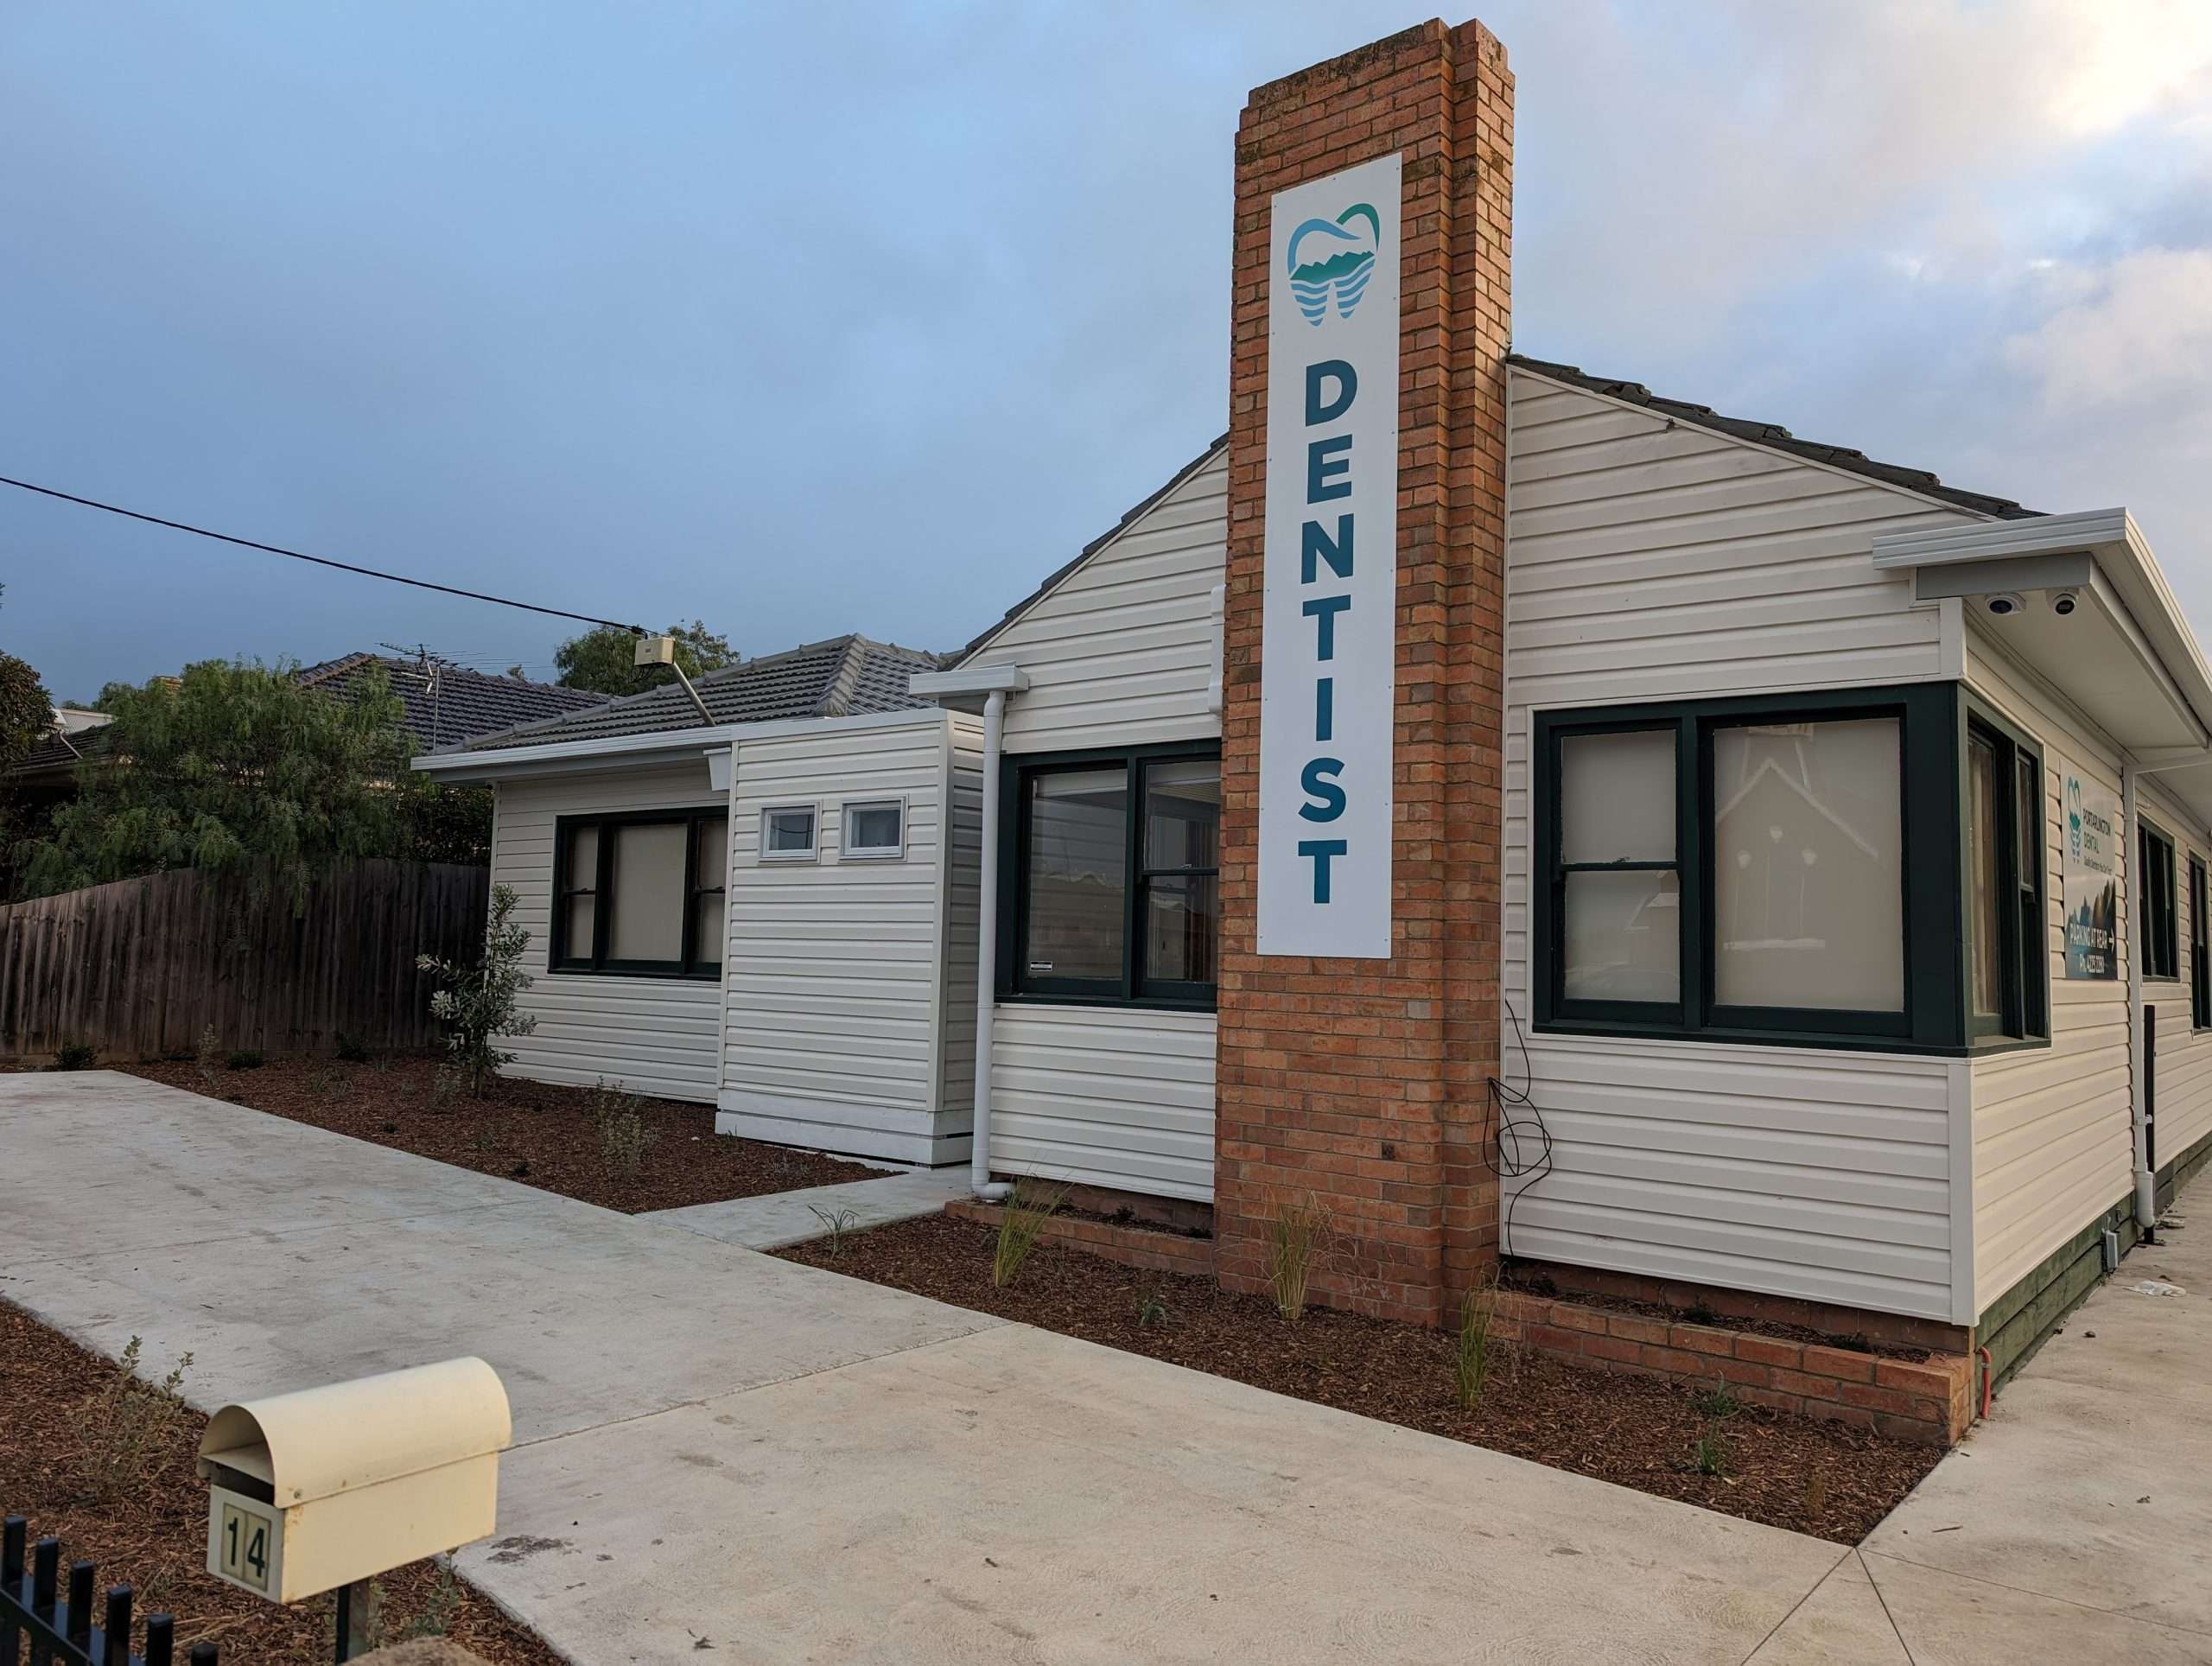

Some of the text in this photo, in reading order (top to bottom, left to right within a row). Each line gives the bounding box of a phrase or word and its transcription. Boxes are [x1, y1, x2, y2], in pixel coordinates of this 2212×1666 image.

[1298, 359, 1358, 904] DENTIST
[2084, 831, 2100, 854] DENTAL
[2070, 923, 2090, 947] PARKING
[2096, 927, 2107, 950] REAR
[227, 1517, 265, 1578] 14
